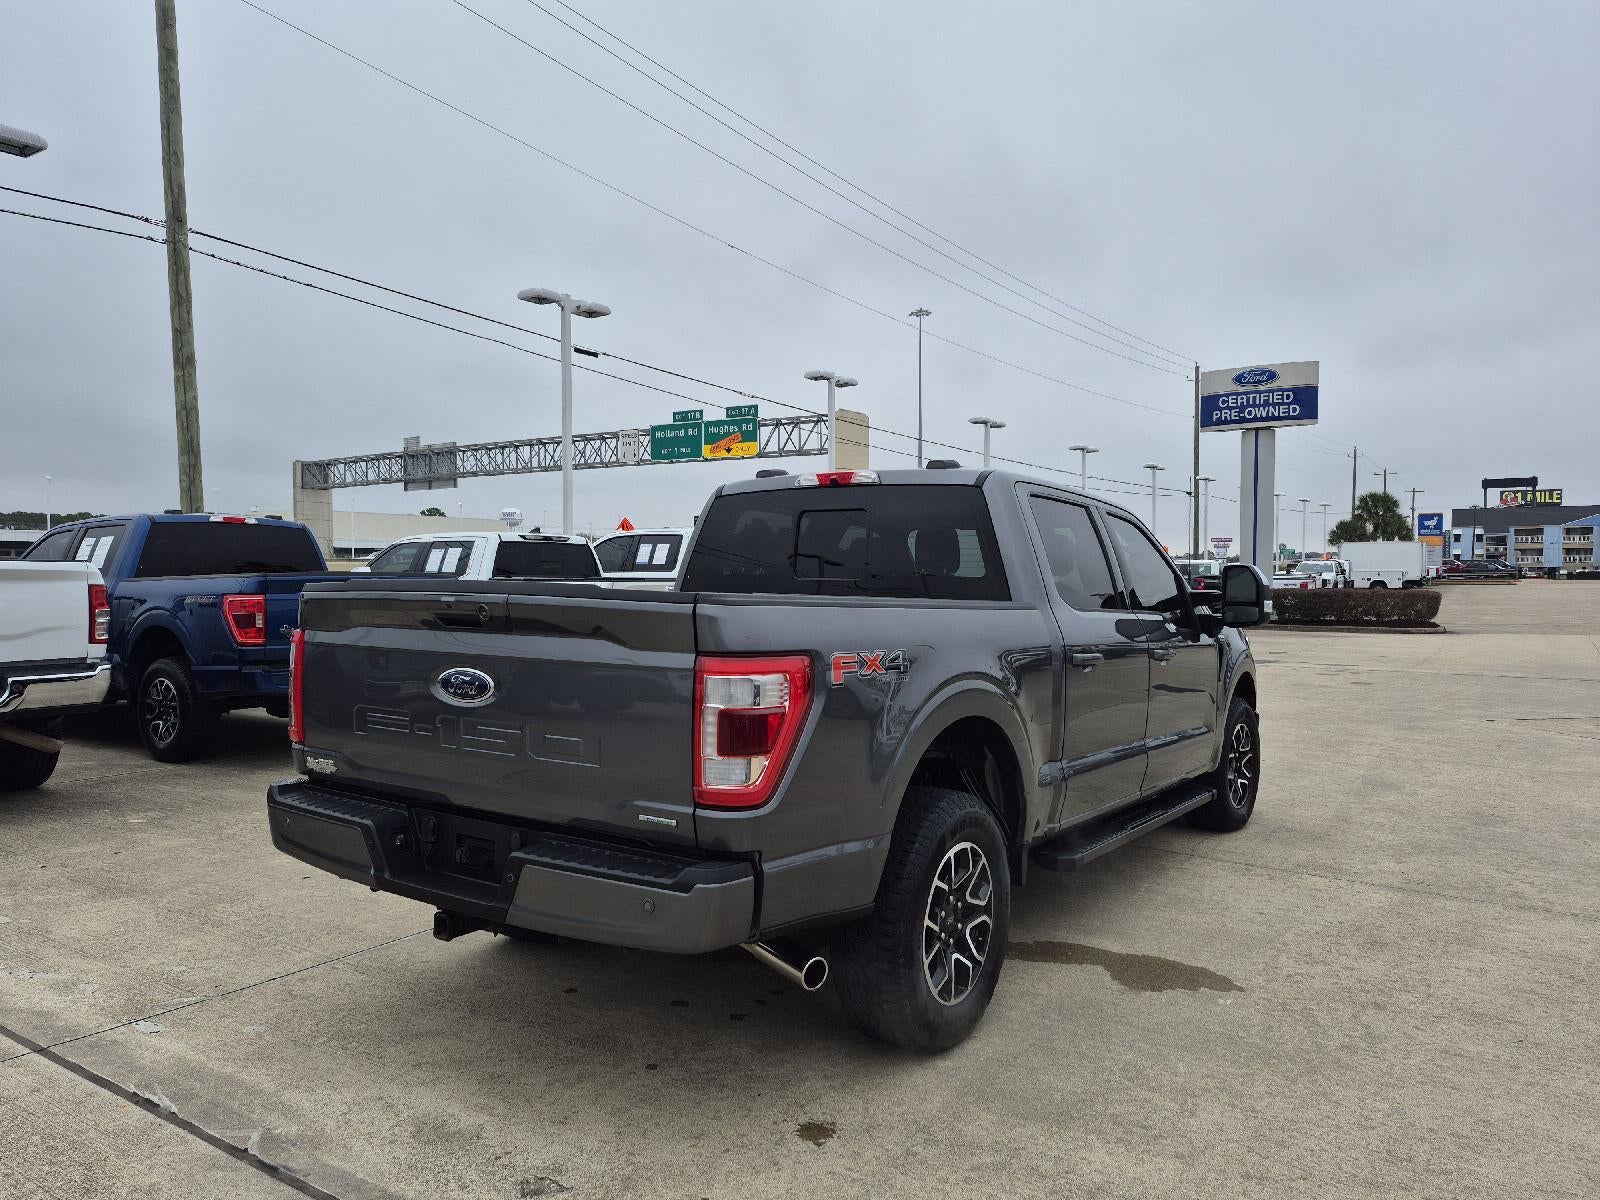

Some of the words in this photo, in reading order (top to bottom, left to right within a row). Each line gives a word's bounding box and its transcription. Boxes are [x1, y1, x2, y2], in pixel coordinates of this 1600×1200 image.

[1241, 370, 1269, 384] Ford
[1218, 392, 1294, 407] CERTIFIED
[1212, 405, 1301, 422] PRE-OWNED
[655, 428, 685, 438] Holland
[687, 427, 698, 437] Rd
[708, 425, 739, 435] Hughes
[742, 423, 753, 432] Rd
[1515, 491, 1522, 503] 1
[1526, 490, 1562, 503] MILE
[830, 648, 910, 689] FX4
[447, 674, 478, 695] Ford
[353, 704, 602, 768] F-150
